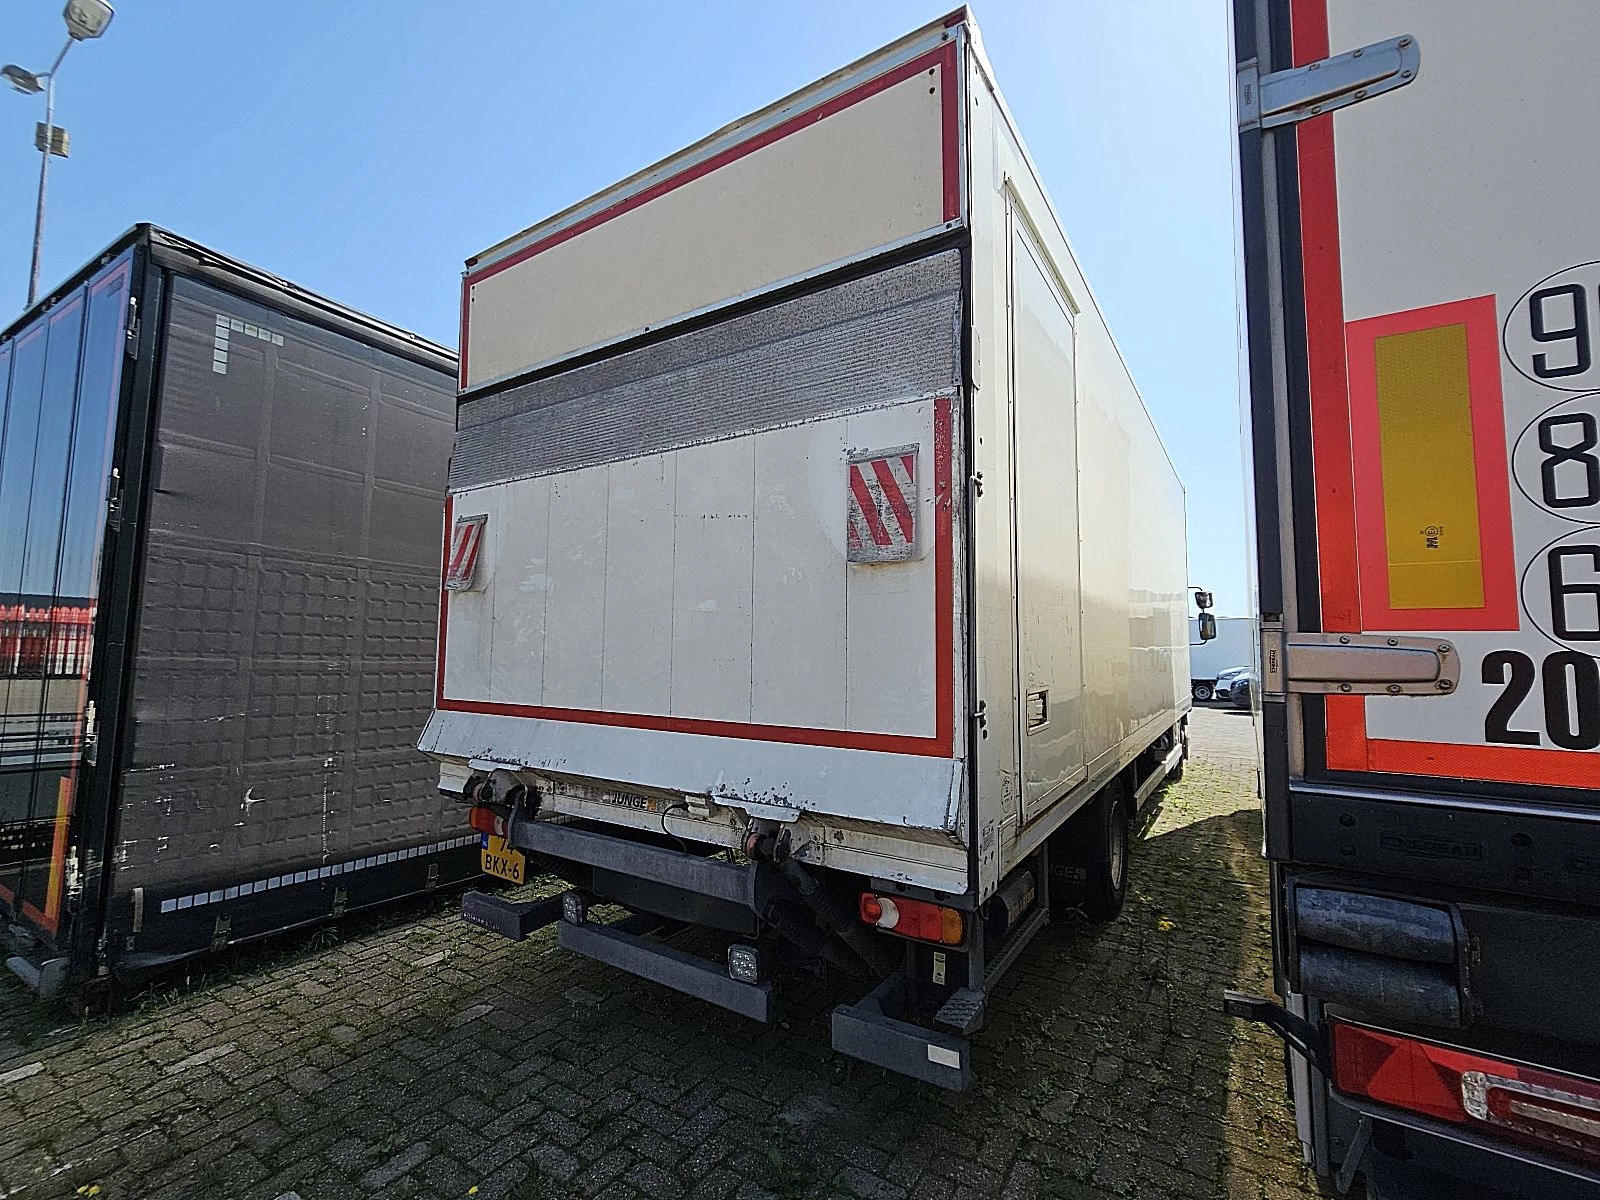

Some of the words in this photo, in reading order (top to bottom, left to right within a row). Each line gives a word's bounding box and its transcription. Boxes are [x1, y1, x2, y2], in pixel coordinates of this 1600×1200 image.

[1529, 283, 1600, 379] 9
[1481, 650, 1600, 752] 20
[485, 854, 519, 880] BKX-6
